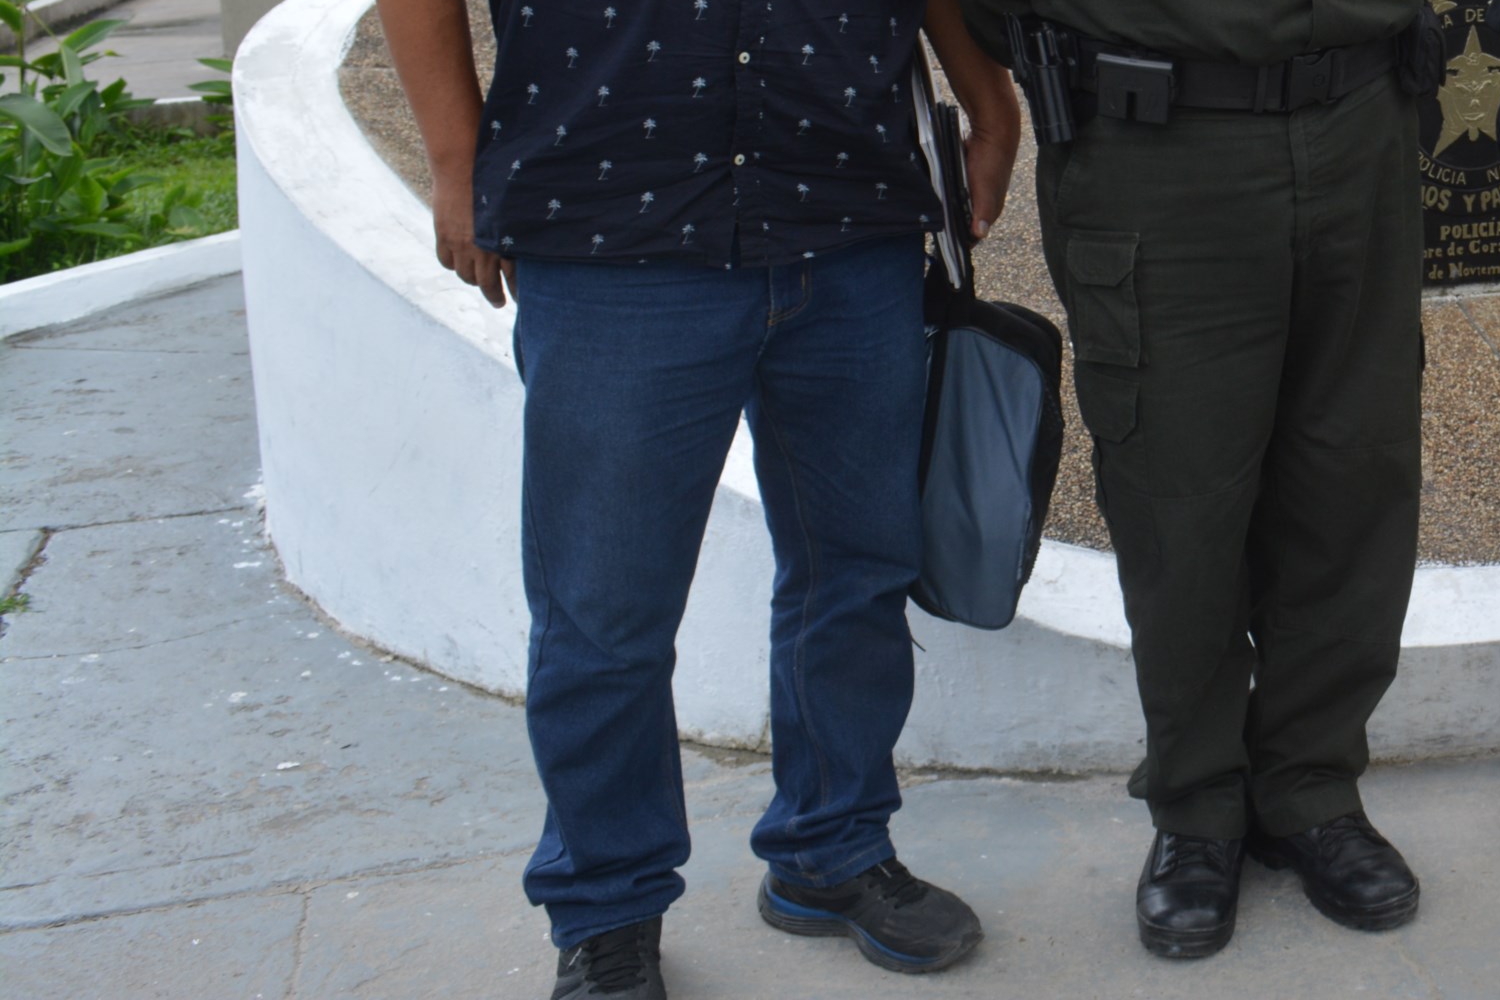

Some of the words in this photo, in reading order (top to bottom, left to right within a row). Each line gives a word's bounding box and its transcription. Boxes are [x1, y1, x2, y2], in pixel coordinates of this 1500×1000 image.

[1465, 8, 1485, 23] DE
[1462, 193, 1476, 214] Y
[1447, 241, 1464, 257] de
[1428, 264, 1444, 280] de
